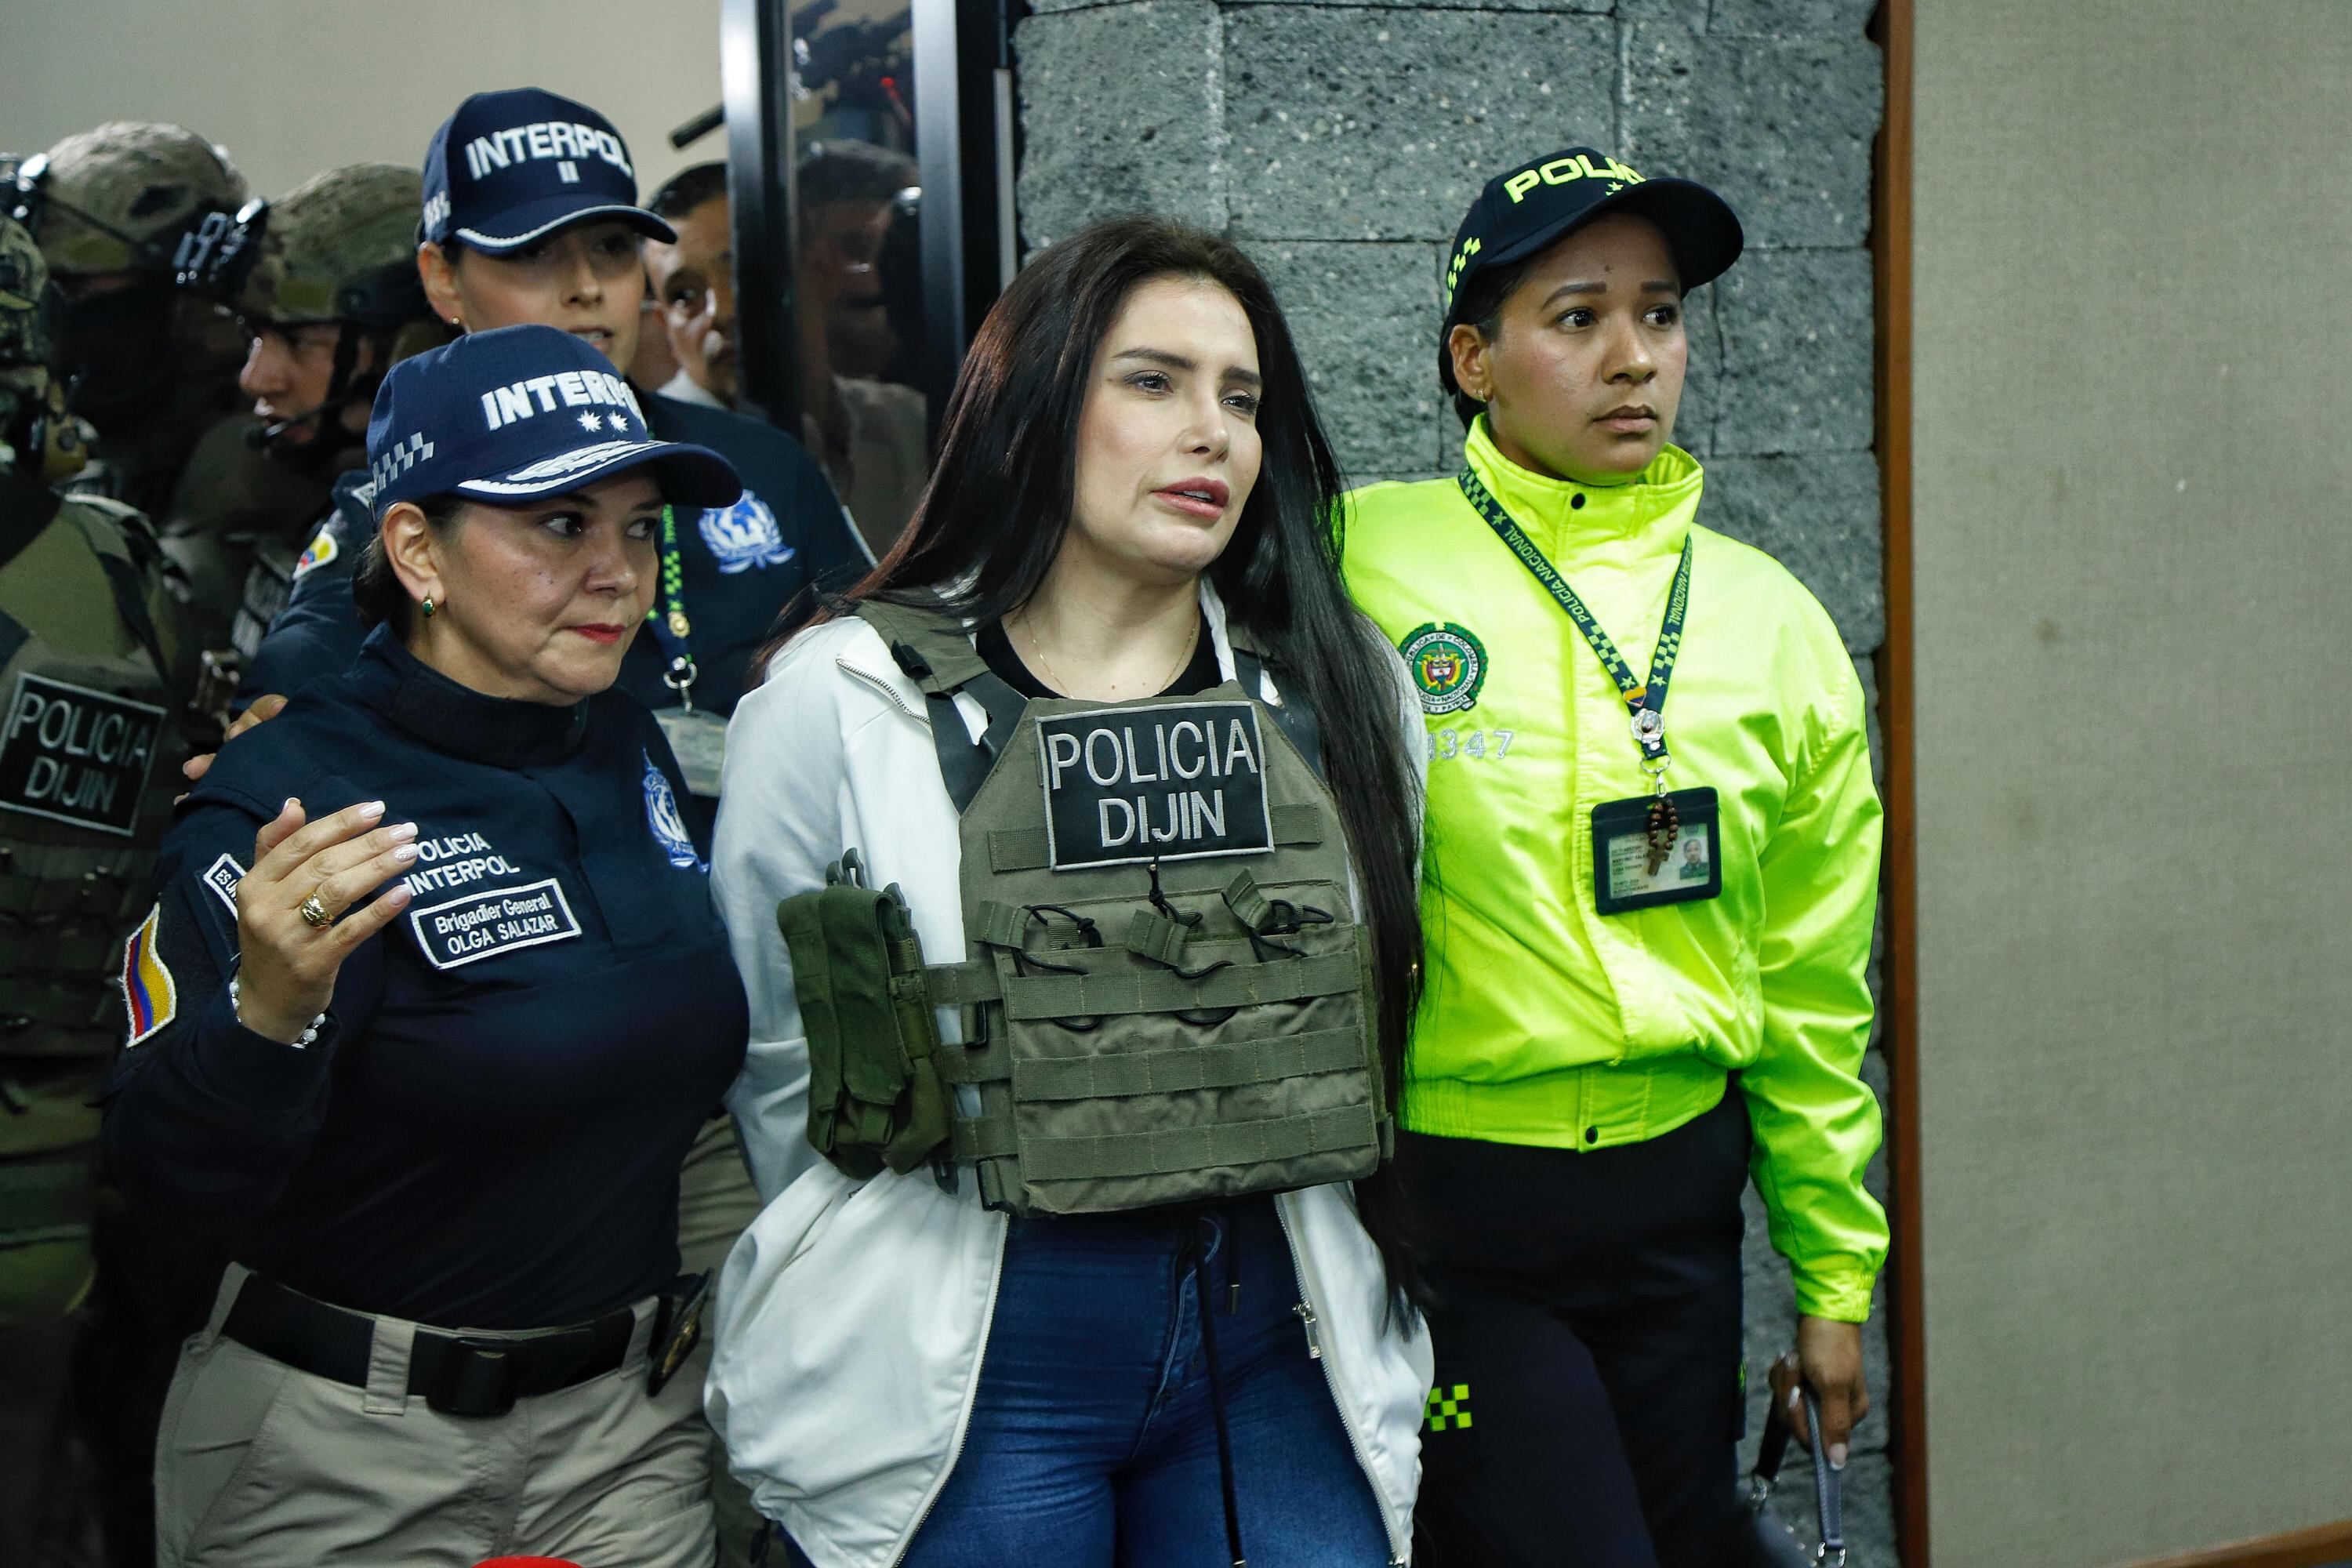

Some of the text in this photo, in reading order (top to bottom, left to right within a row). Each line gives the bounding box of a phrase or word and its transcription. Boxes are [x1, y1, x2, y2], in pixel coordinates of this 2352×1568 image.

[466, 122, 633, 181] INTERPOL
[1505, 524, 1555, 581] NACIONAL
[1668, 573, 1687, 626] NACIONAL
[9, 691, 151, 769] POLICIA
[1048, 718, 1258, 789] POLICIA
[24, 756, 118, 814] DIJIN
[1098, 789, 1226, 848] DIJIN
[417, 832, 492, 862] OLICIA
[214, 869, 232, 885] ES
[403, 855, 521, 897] INTERPOL
[434, 892, 554, 935] Brigadier General
[447, 914, 559, 955] OLGA SALAZAR
